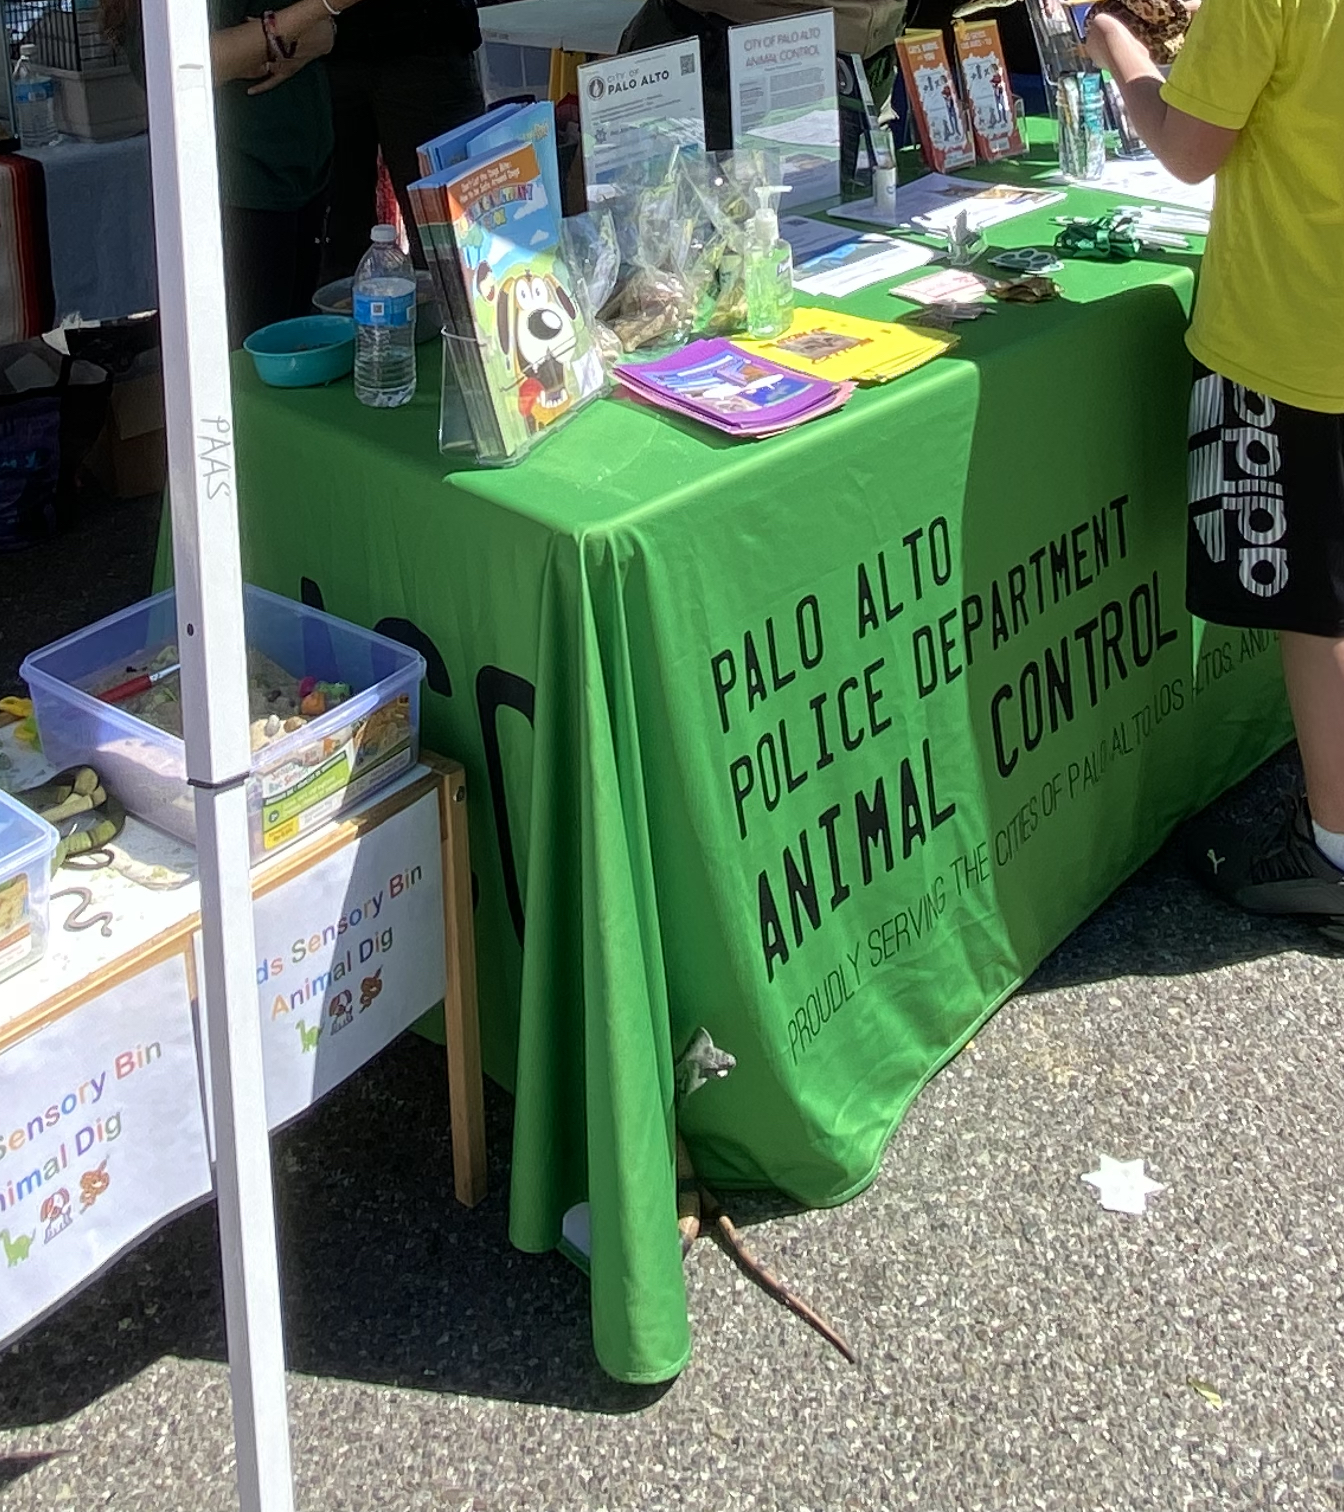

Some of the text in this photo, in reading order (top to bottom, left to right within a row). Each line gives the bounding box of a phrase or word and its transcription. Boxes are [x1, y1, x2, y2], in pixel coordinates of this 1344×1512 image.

[607, 68, 639, 83] CITY OF
[744, 27, 821, 51] CITY OF PALO ALTO
[746, 53, 778, 67] ANIMAL
[779, 44, 820, 62] CONTROL
[608, 70, 669, 95] PALO ALTO
[198, 415, 232, 500] PAAS
[710, 515, 953, 734] PALO ALTO
[730, 657, 892, 841] POLICE
[912, 494, 1130, 700] DEPARTMENT
[757, 737, 956, 984] ANIMAL
[989, 570, 1179, 779] CONTROL
[291, 890, 383, 964] Sensory
[389, 865, 422, 899] Bin
[787, 941, 866, 1067] PROUDLY
[867, 876, 946, 968] SERVING
[951, 841, 991, 896] THE
[1041, 772, 1062, 817] OF
[1068, 739, 1106, 799] PALO
[1154, 678, 1185, 724] LOS
[272, 926, 394, 1021] Animal Dig
[114, 1041, 163, 1080] Bin
[75, 1110, 122, 1158] Dig
